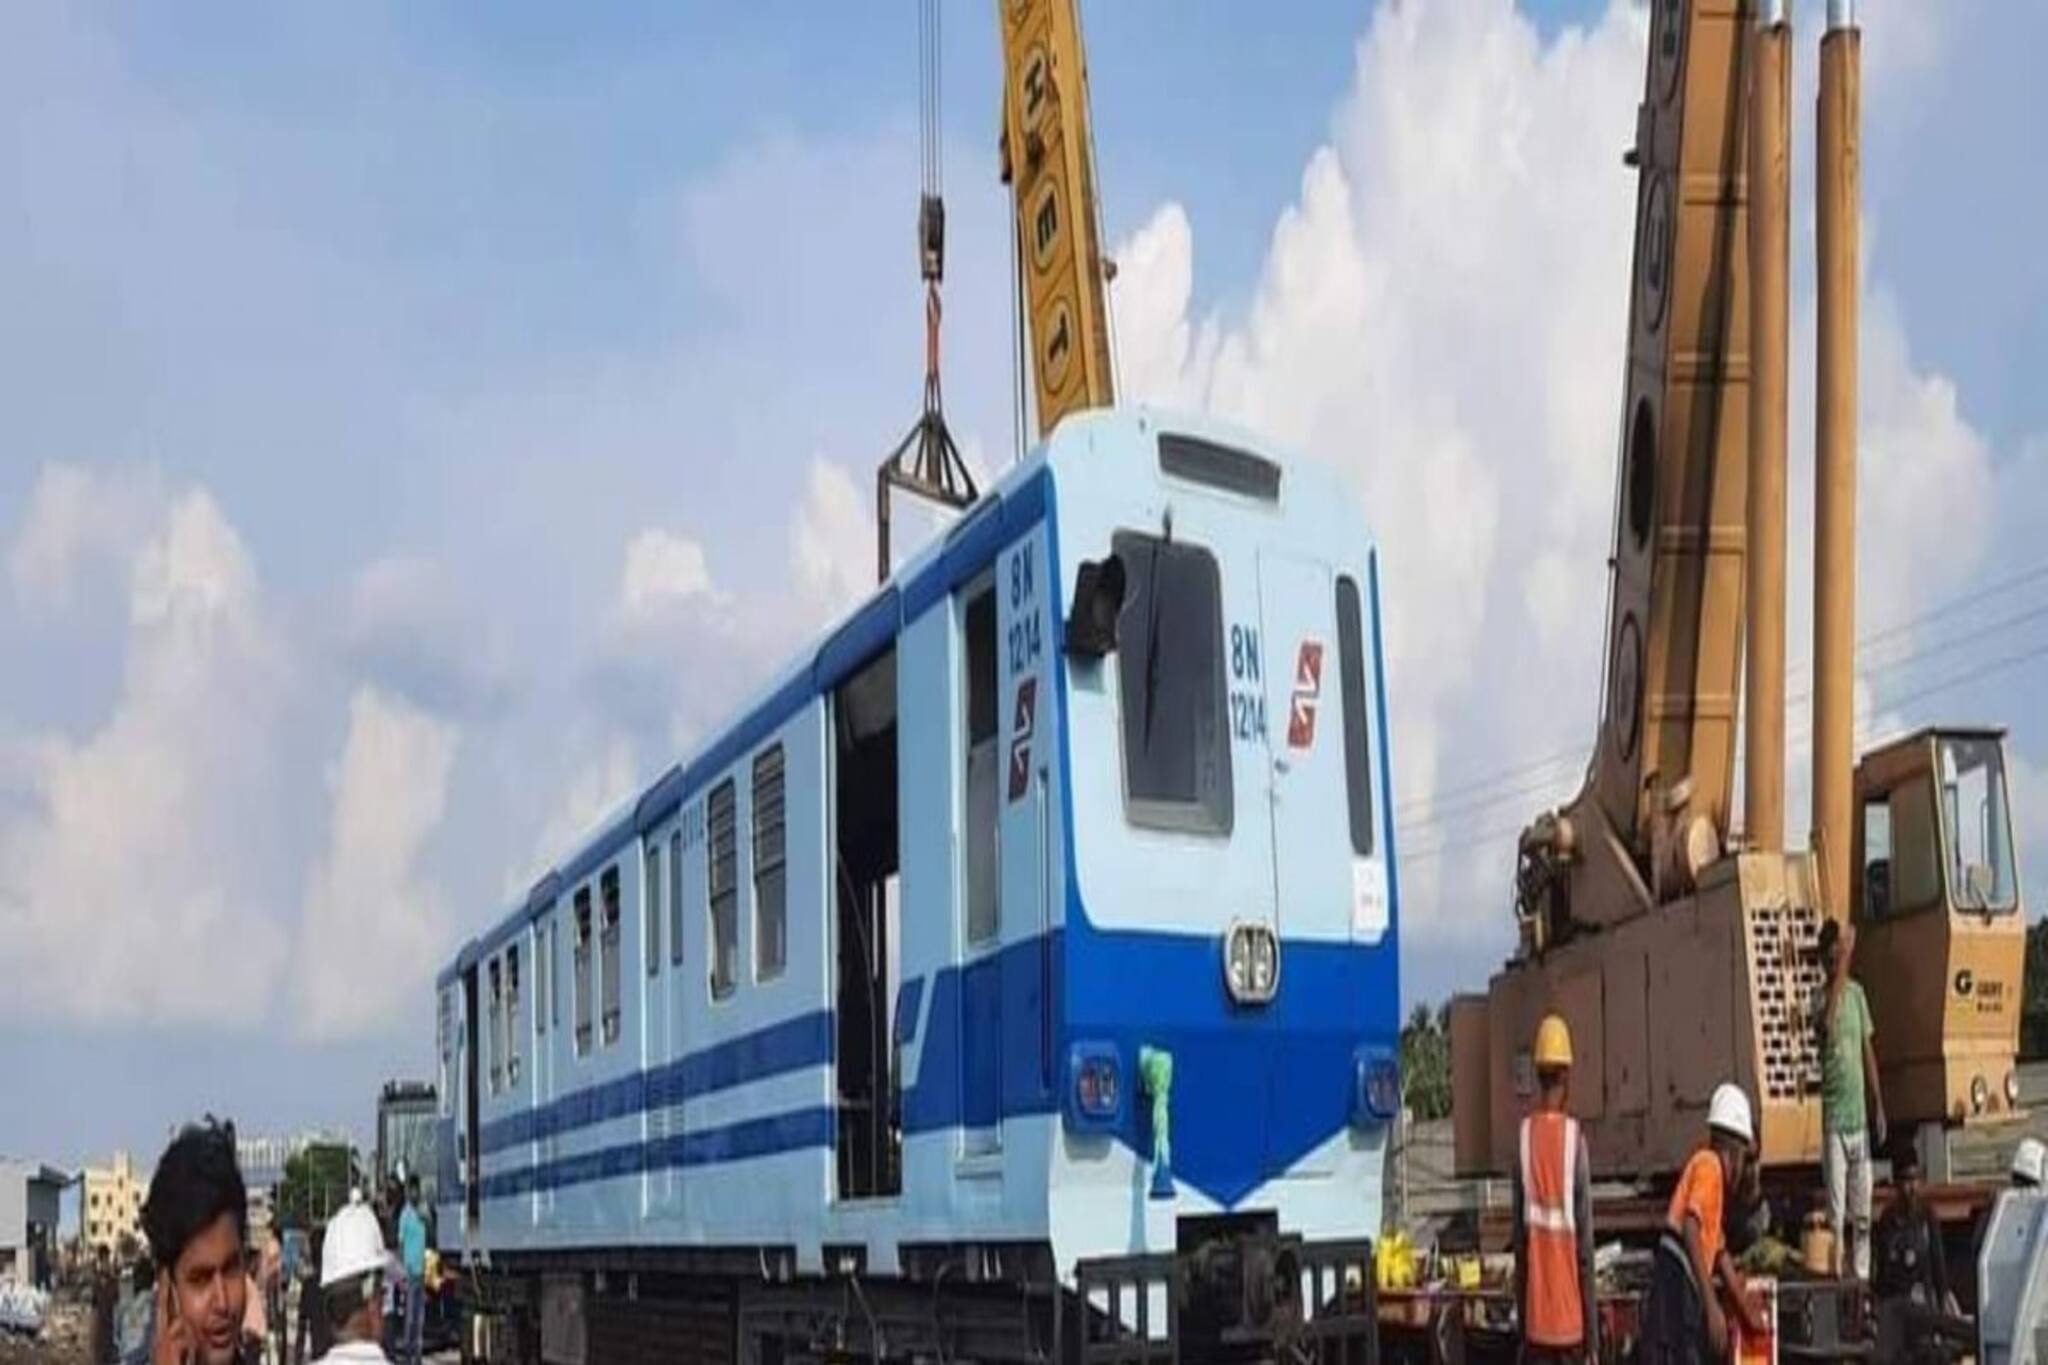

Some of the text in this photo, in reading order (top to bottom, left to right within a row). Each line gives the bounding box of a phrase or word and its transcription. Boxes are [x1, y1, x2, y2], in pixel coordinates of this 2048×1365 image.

[1011, 541, 1033, 611] 8N
[1009, 608, 1041, 676] 1214
[1231, 624, 1260, 682] 8N
[1231, 691, 1266, 743] 1214
